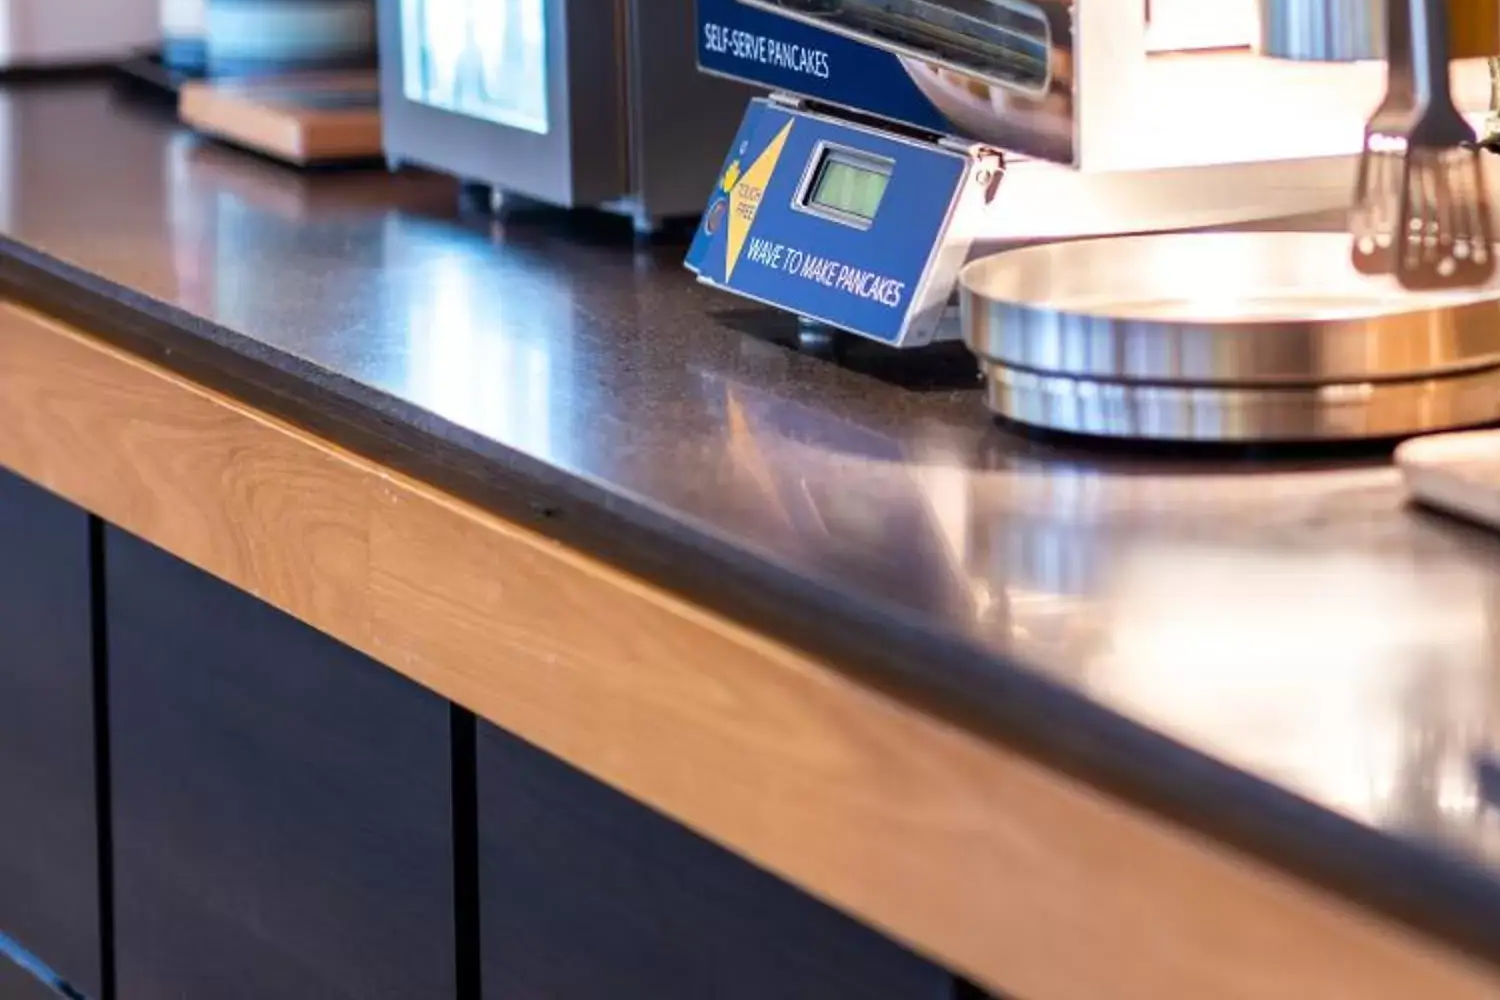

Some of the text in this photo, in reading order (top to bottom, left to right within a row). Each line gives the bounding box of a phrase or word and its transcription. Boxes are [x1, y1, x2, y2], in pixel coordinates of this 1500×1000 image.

[704, 22, 829, 79] SELF-SERVE PANCAKES
[747, 237, 905, 307] WAVE TO MAKE PANCAKES
